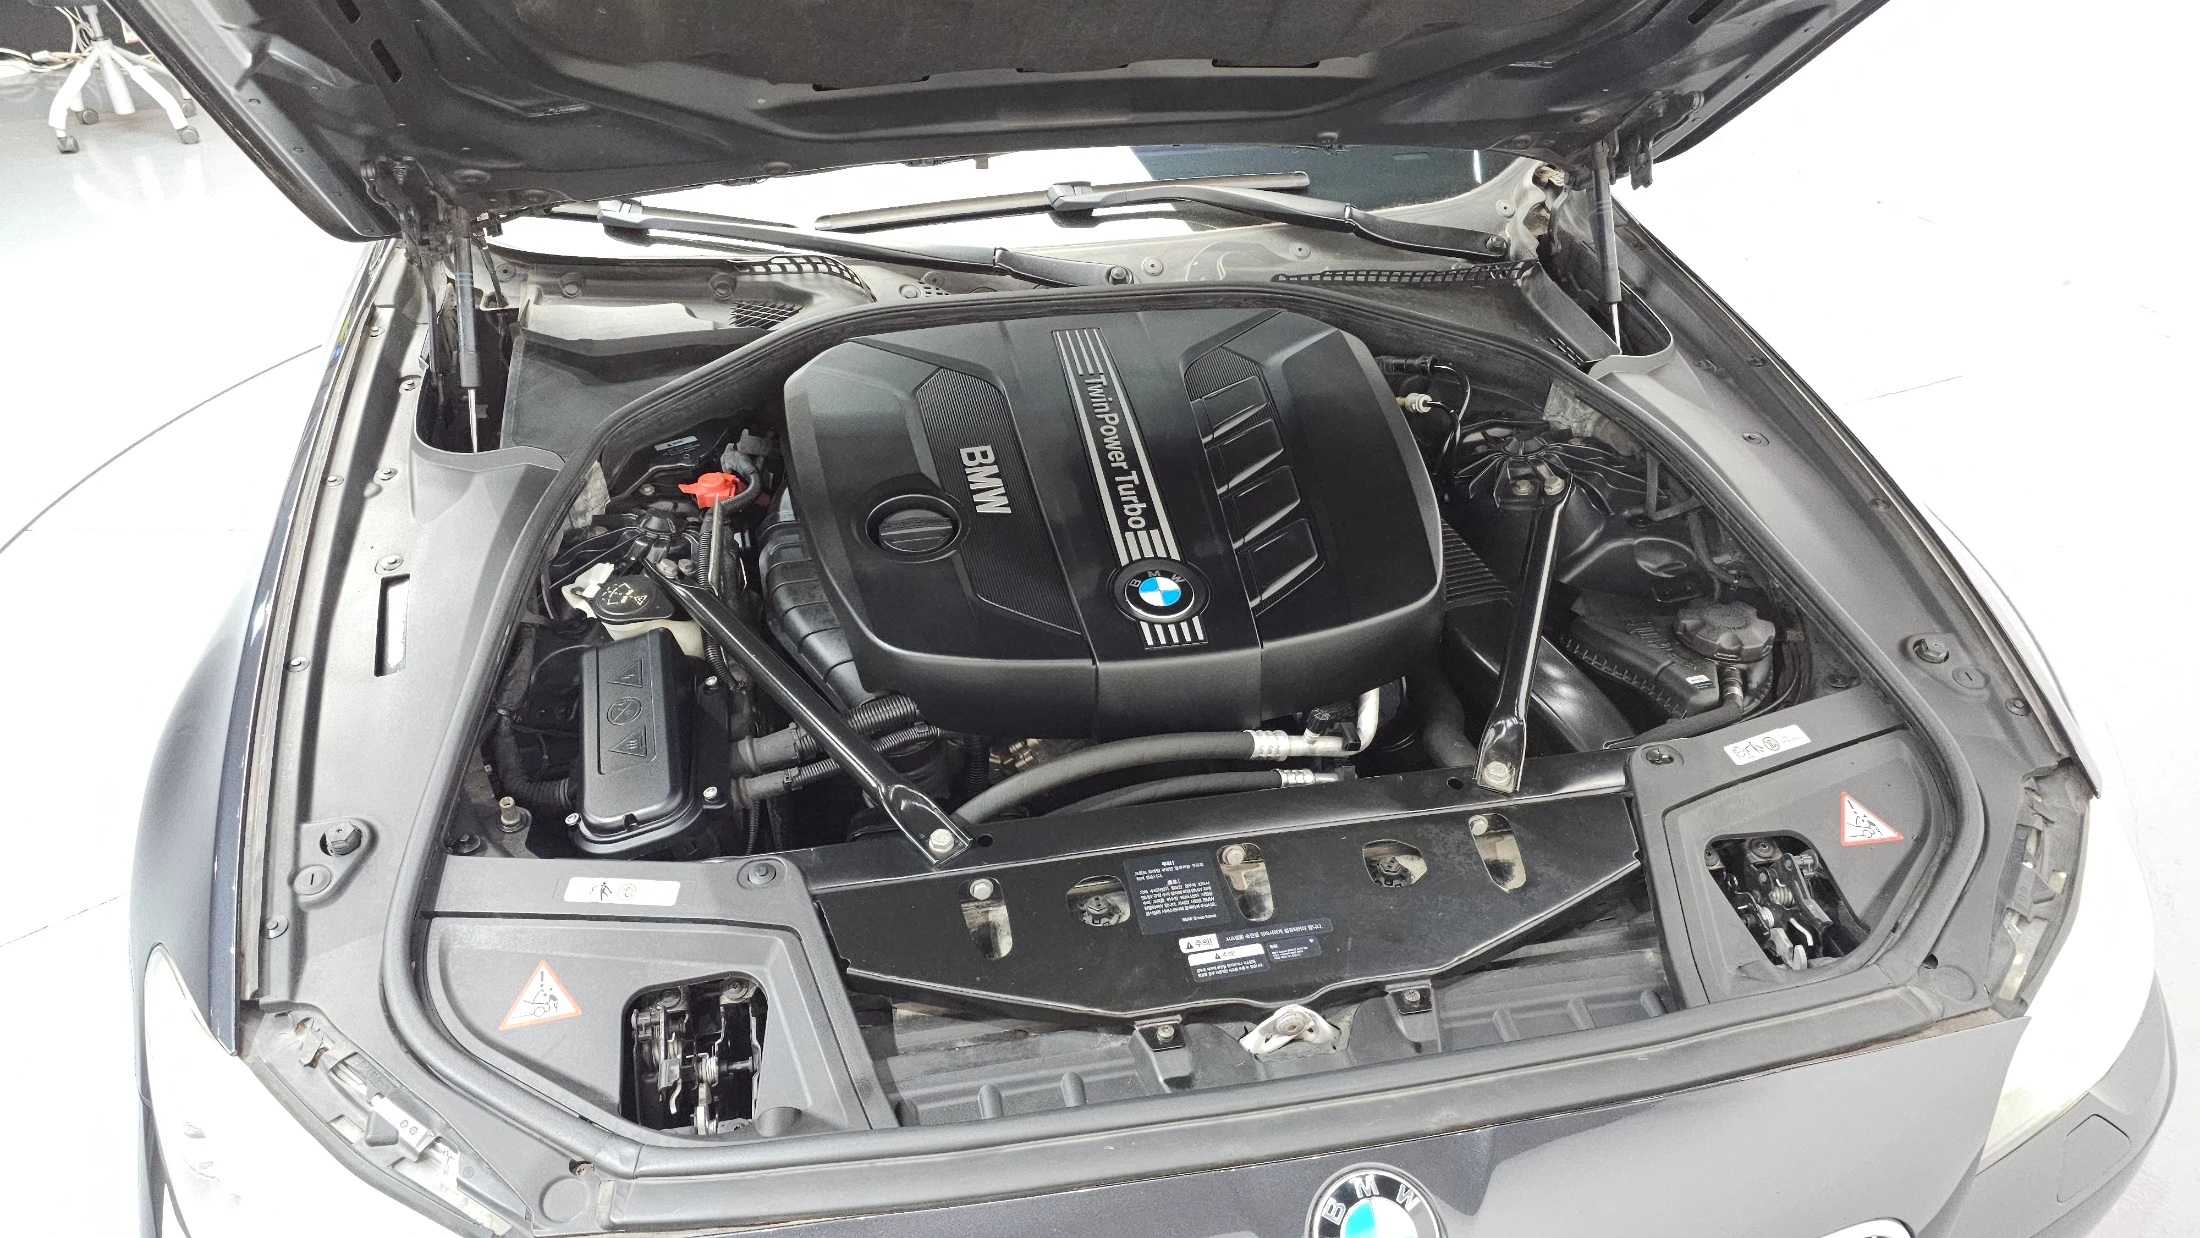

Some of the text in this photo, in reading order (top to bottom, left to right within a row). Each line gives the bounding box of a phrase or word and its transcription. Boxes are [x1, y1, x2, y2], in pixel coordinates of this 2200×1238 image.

[960, 445, 1012, 514] BMW
[1085, 373, 1147, 529] TwinPower Turbo
[1129, 570, 1185, 588] BMW
[1321, 1173, 1421, 1226] BMW
